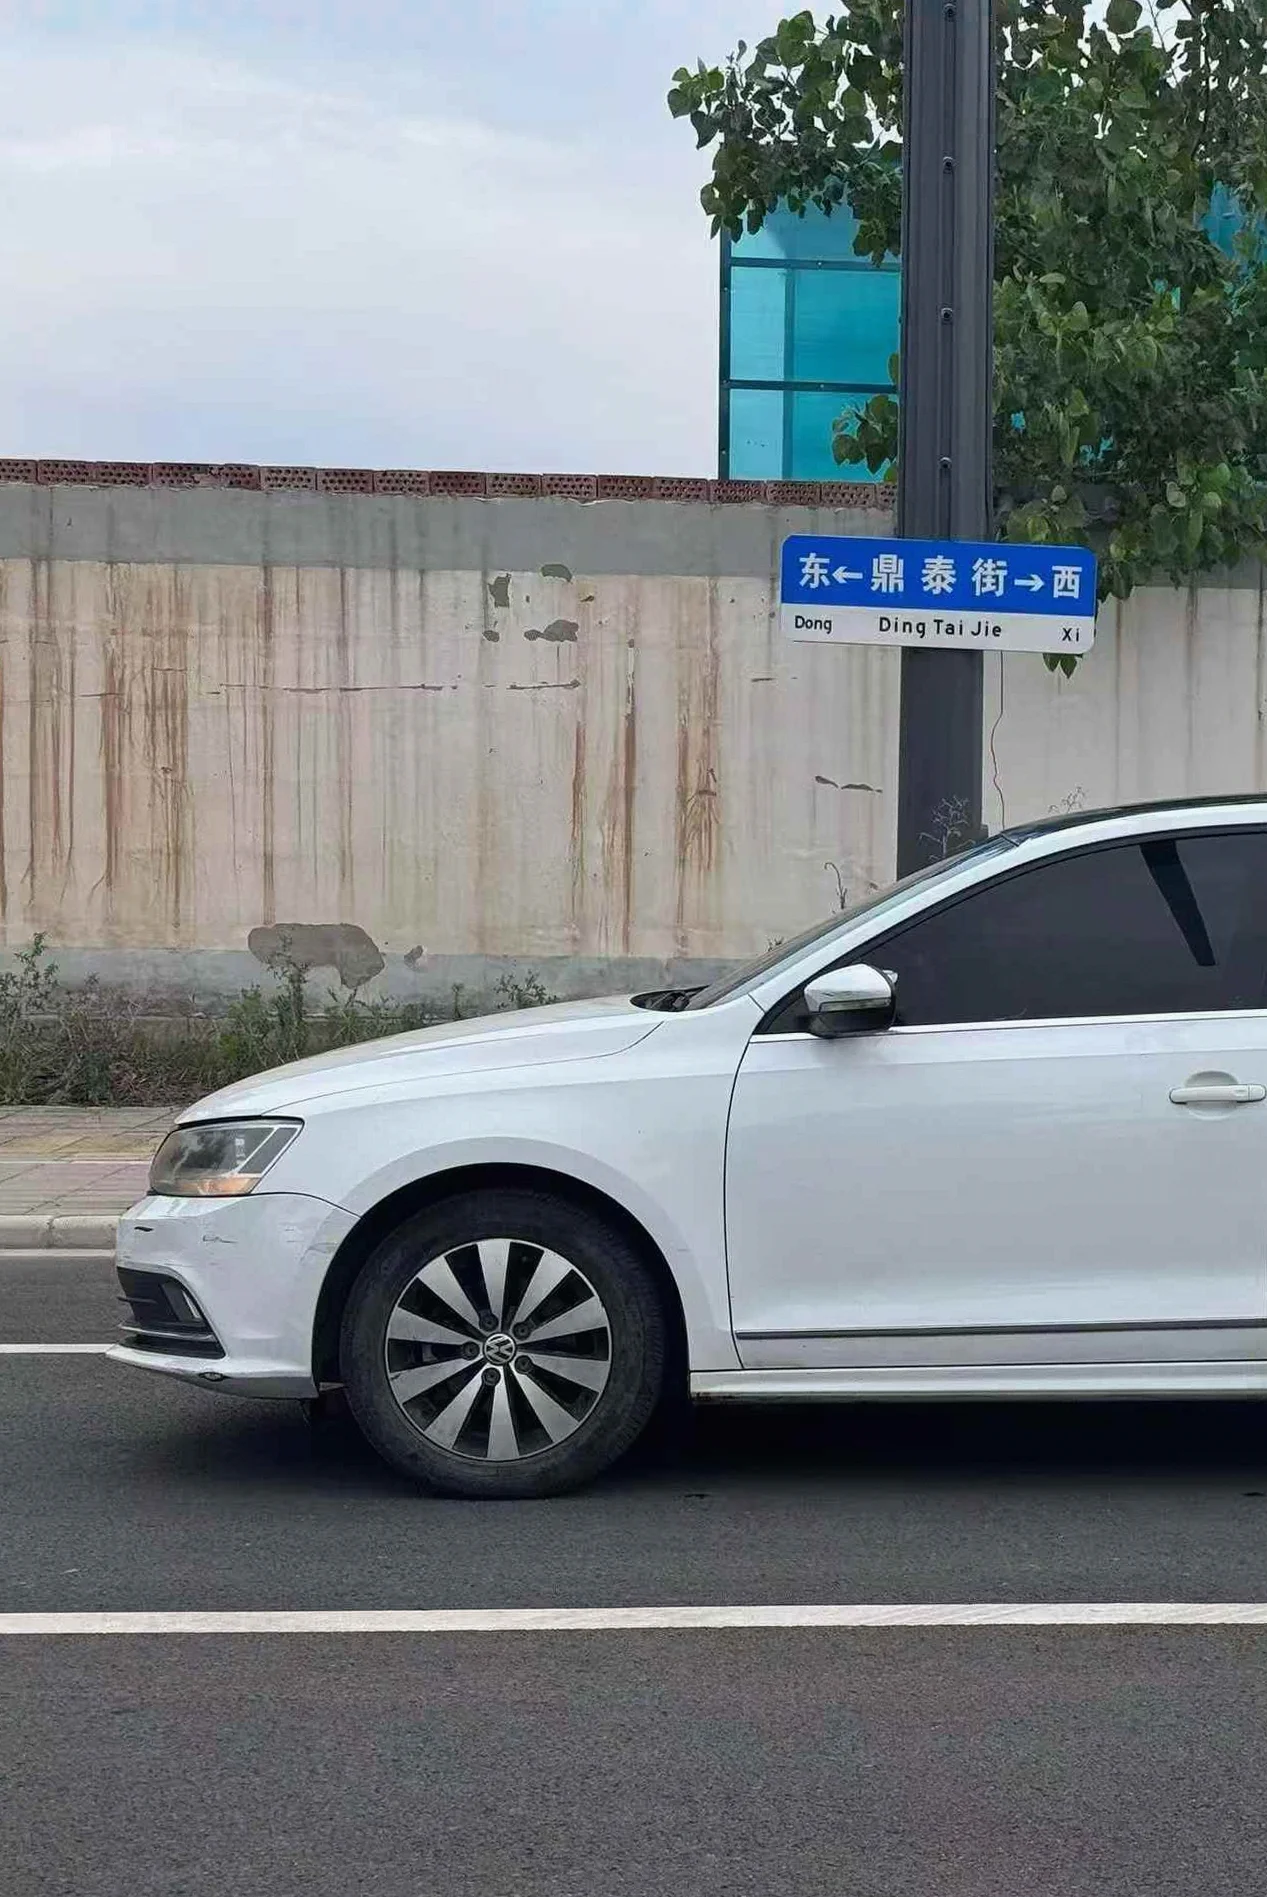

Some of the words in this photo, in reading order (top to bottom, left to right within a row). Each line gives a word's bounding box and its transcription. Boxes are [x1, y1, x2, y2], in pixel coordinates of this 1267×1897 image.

[799, 552, 830, 589] 东
[871, 554, 1008, 597] 鼎泰街
[1052, 565, 1082, 599] 西
[794, 614, 832, 635] Dong
[879, 616, 926, 638] Ding
[933, 618, 963, 636] Tai
[970, 620, 1002, 638] Jie
[1061, 627, 1080, 642] Xi
